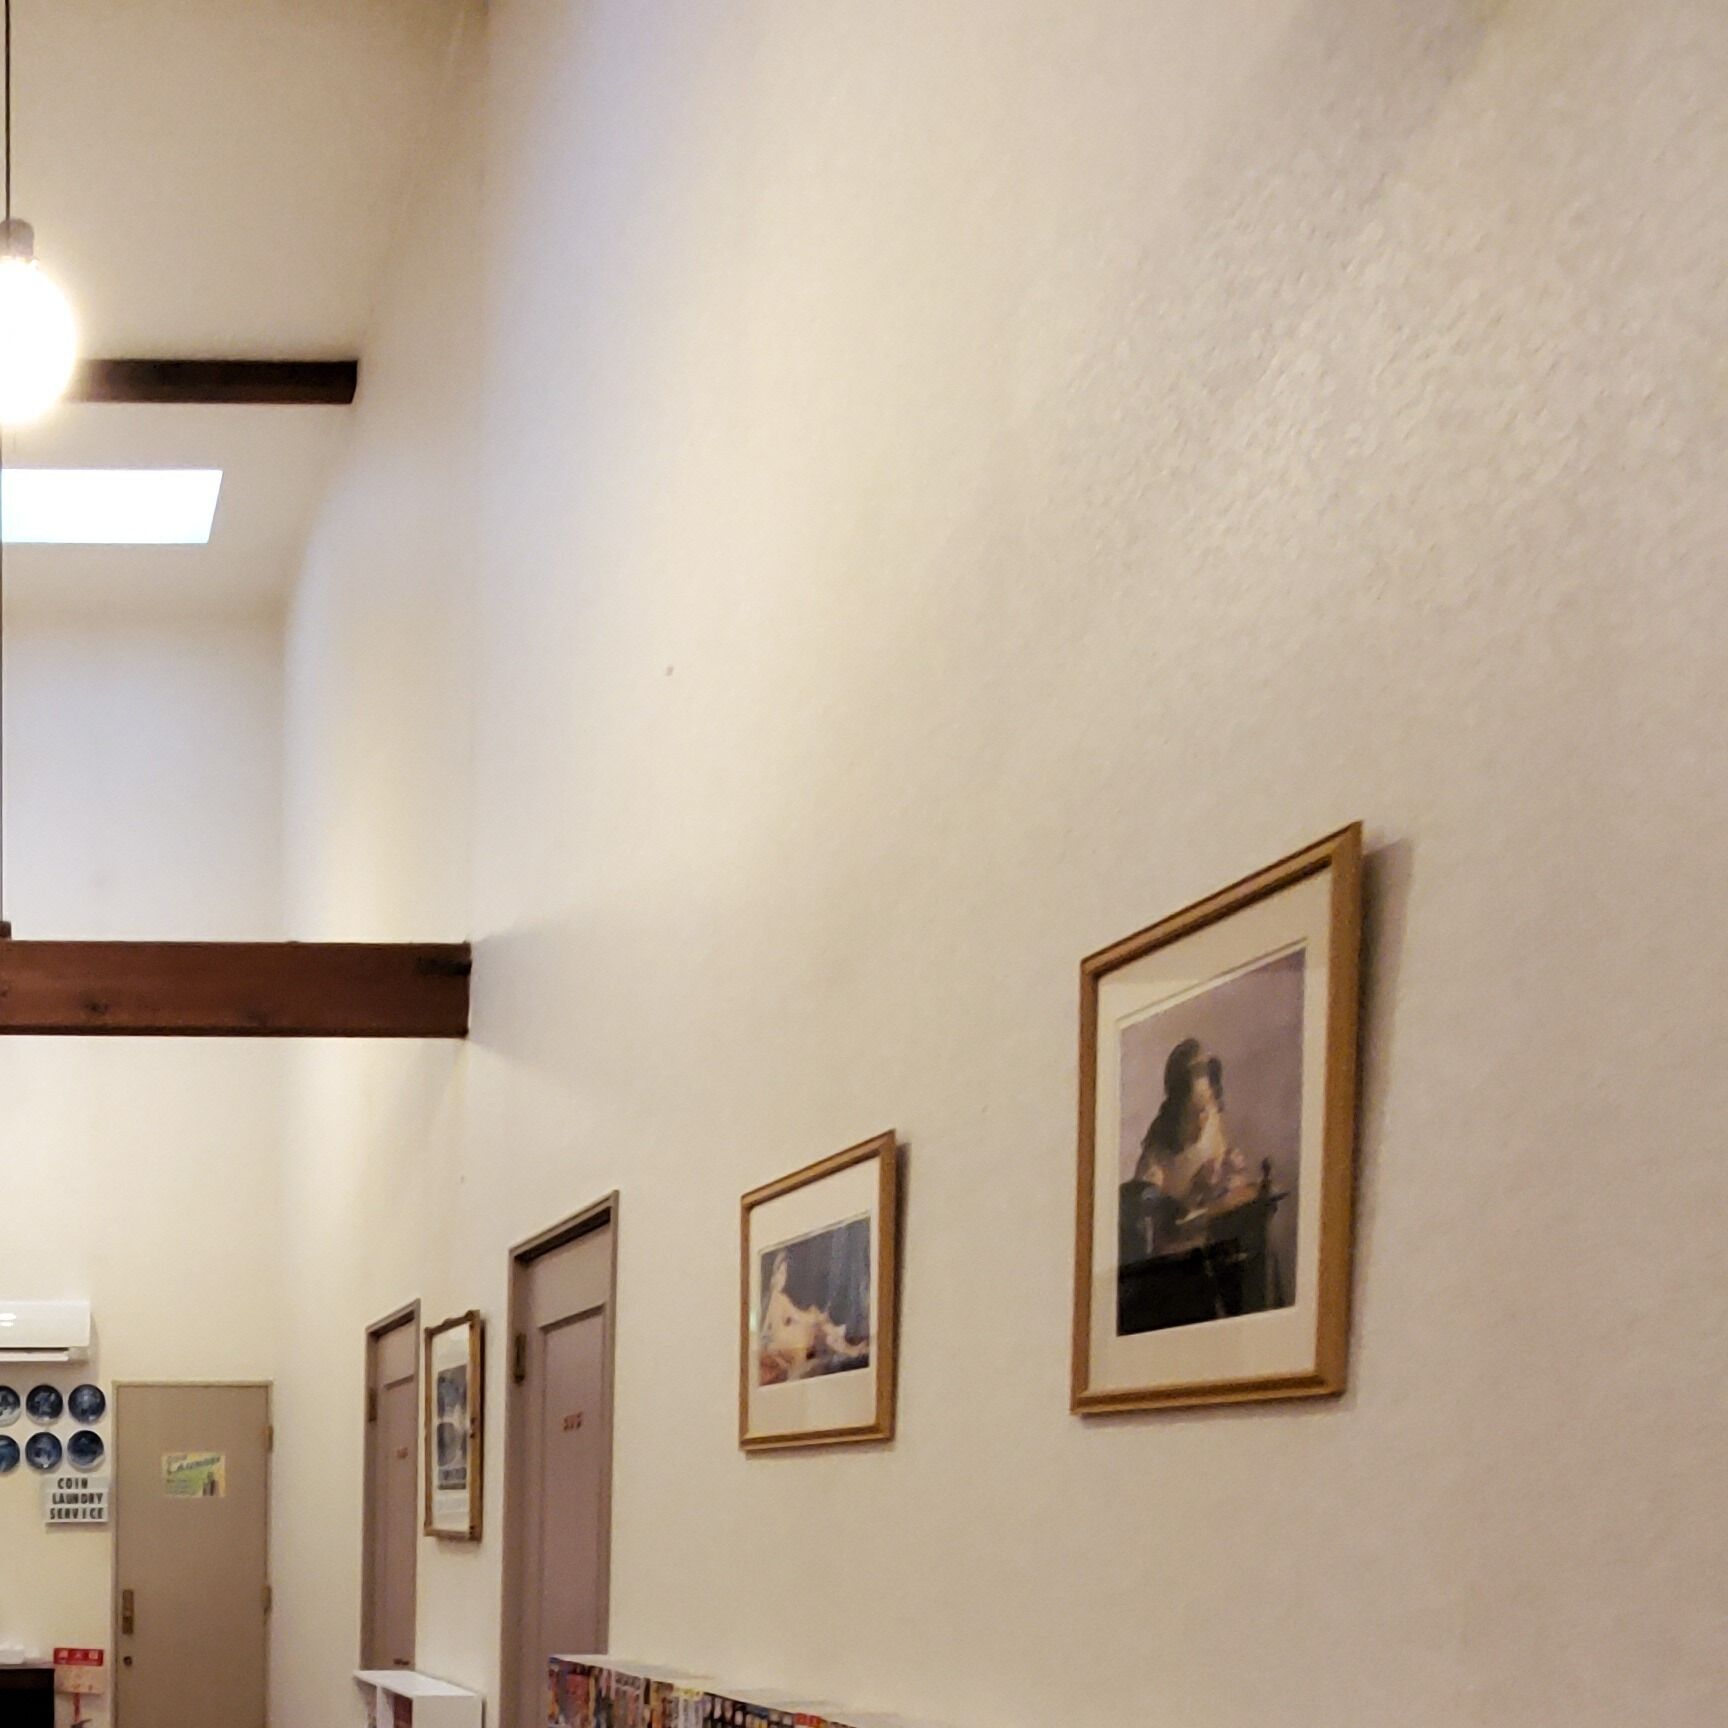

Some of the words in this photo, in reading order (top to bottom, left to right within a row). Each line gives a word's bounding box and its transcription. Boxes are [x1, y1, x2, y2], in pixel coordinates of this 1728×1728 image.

[57, 1477, 89, 1489] COIN
[52, 1493, 104, 1504] LAUNDRY
[50, 1507, 104, 1520] SERVICE
